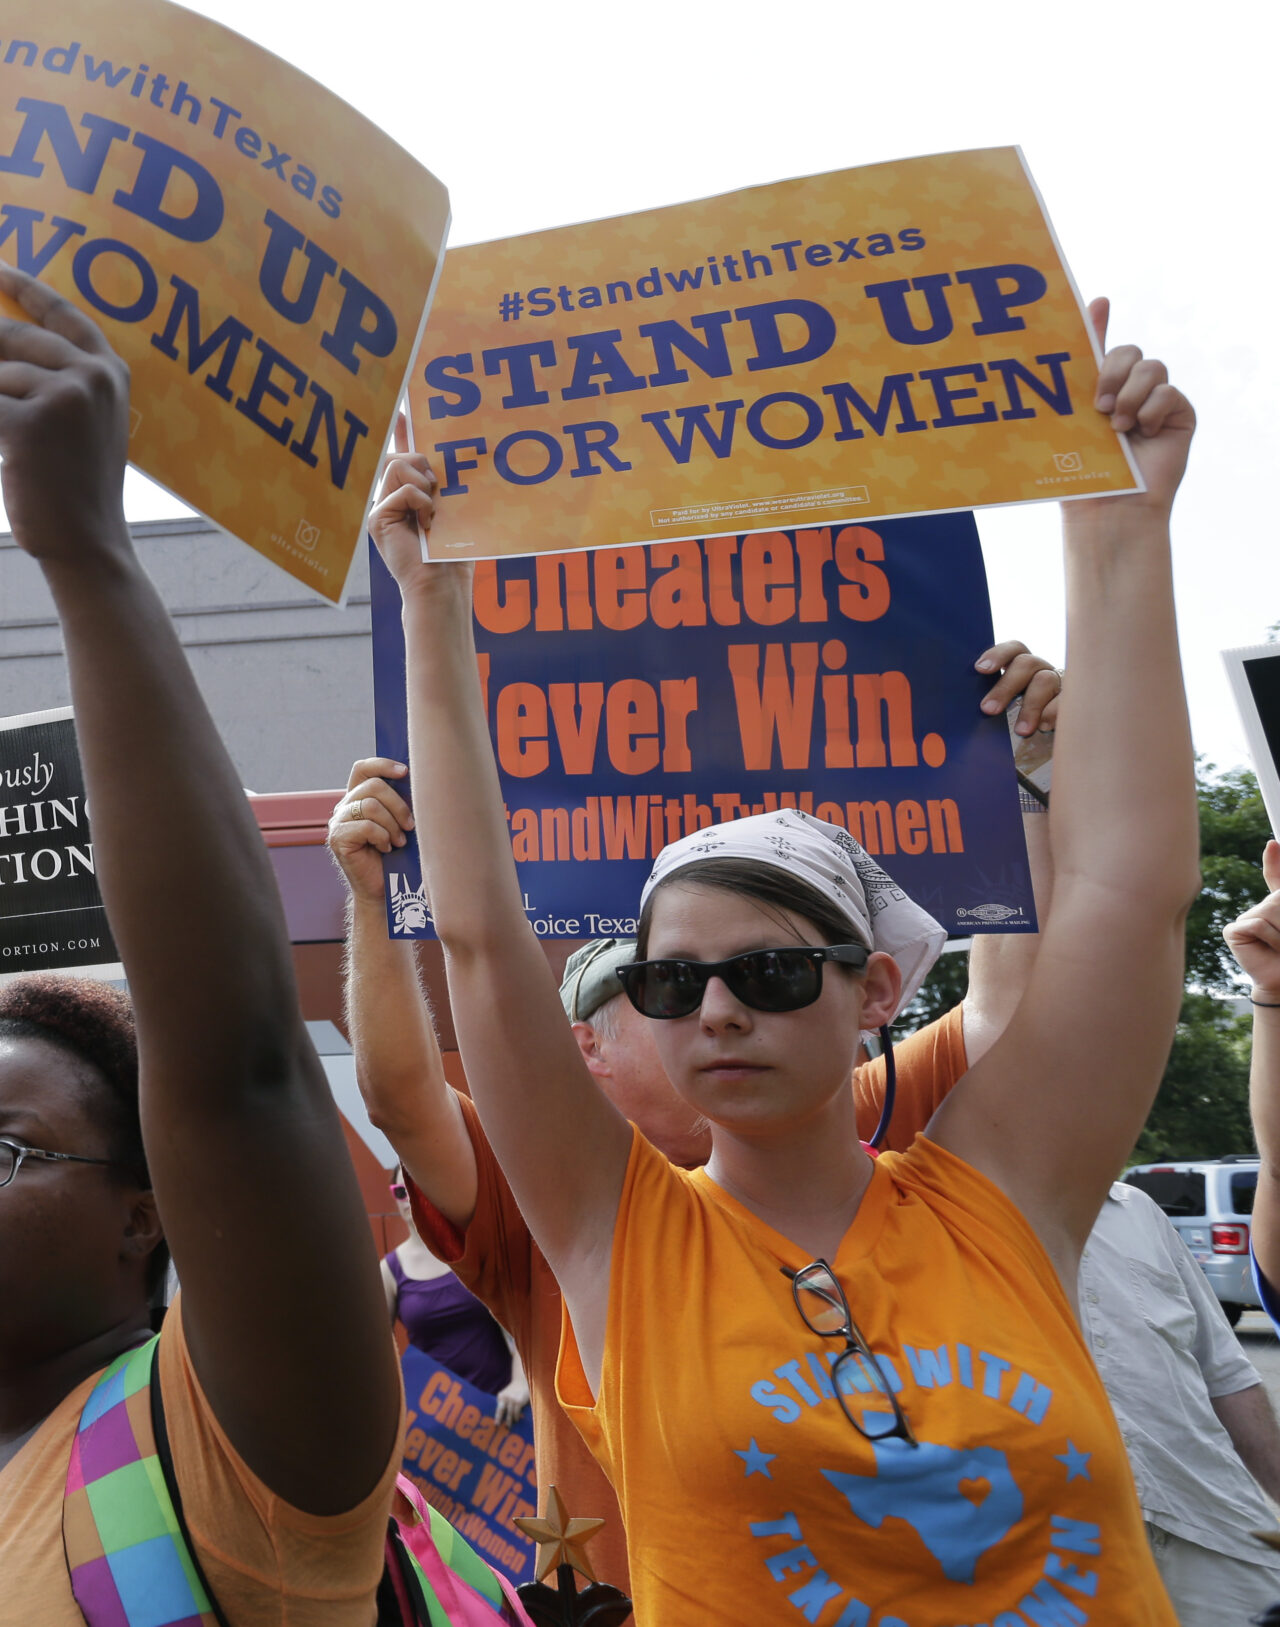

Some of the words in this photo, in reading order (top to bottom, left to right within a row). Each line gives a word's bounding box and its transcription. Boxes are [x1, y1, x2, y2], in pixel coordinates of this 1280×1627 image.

[258, 208, 399, 377] UP
[424, 299, 837, 421] STAND
[865, 263, 1048, 345] UP
[499, 227, 926, 322] #StandwithTexas
[436, 420, 632, 497] FOR
[642, 351, 1075, 465] WOMEN
[477, 653, 698, 779] ever
[728, 639, 947, 772] Win.
[750, 1349, 904, 1424] STAND
[902, 1342, 1053, 1426] WITH
